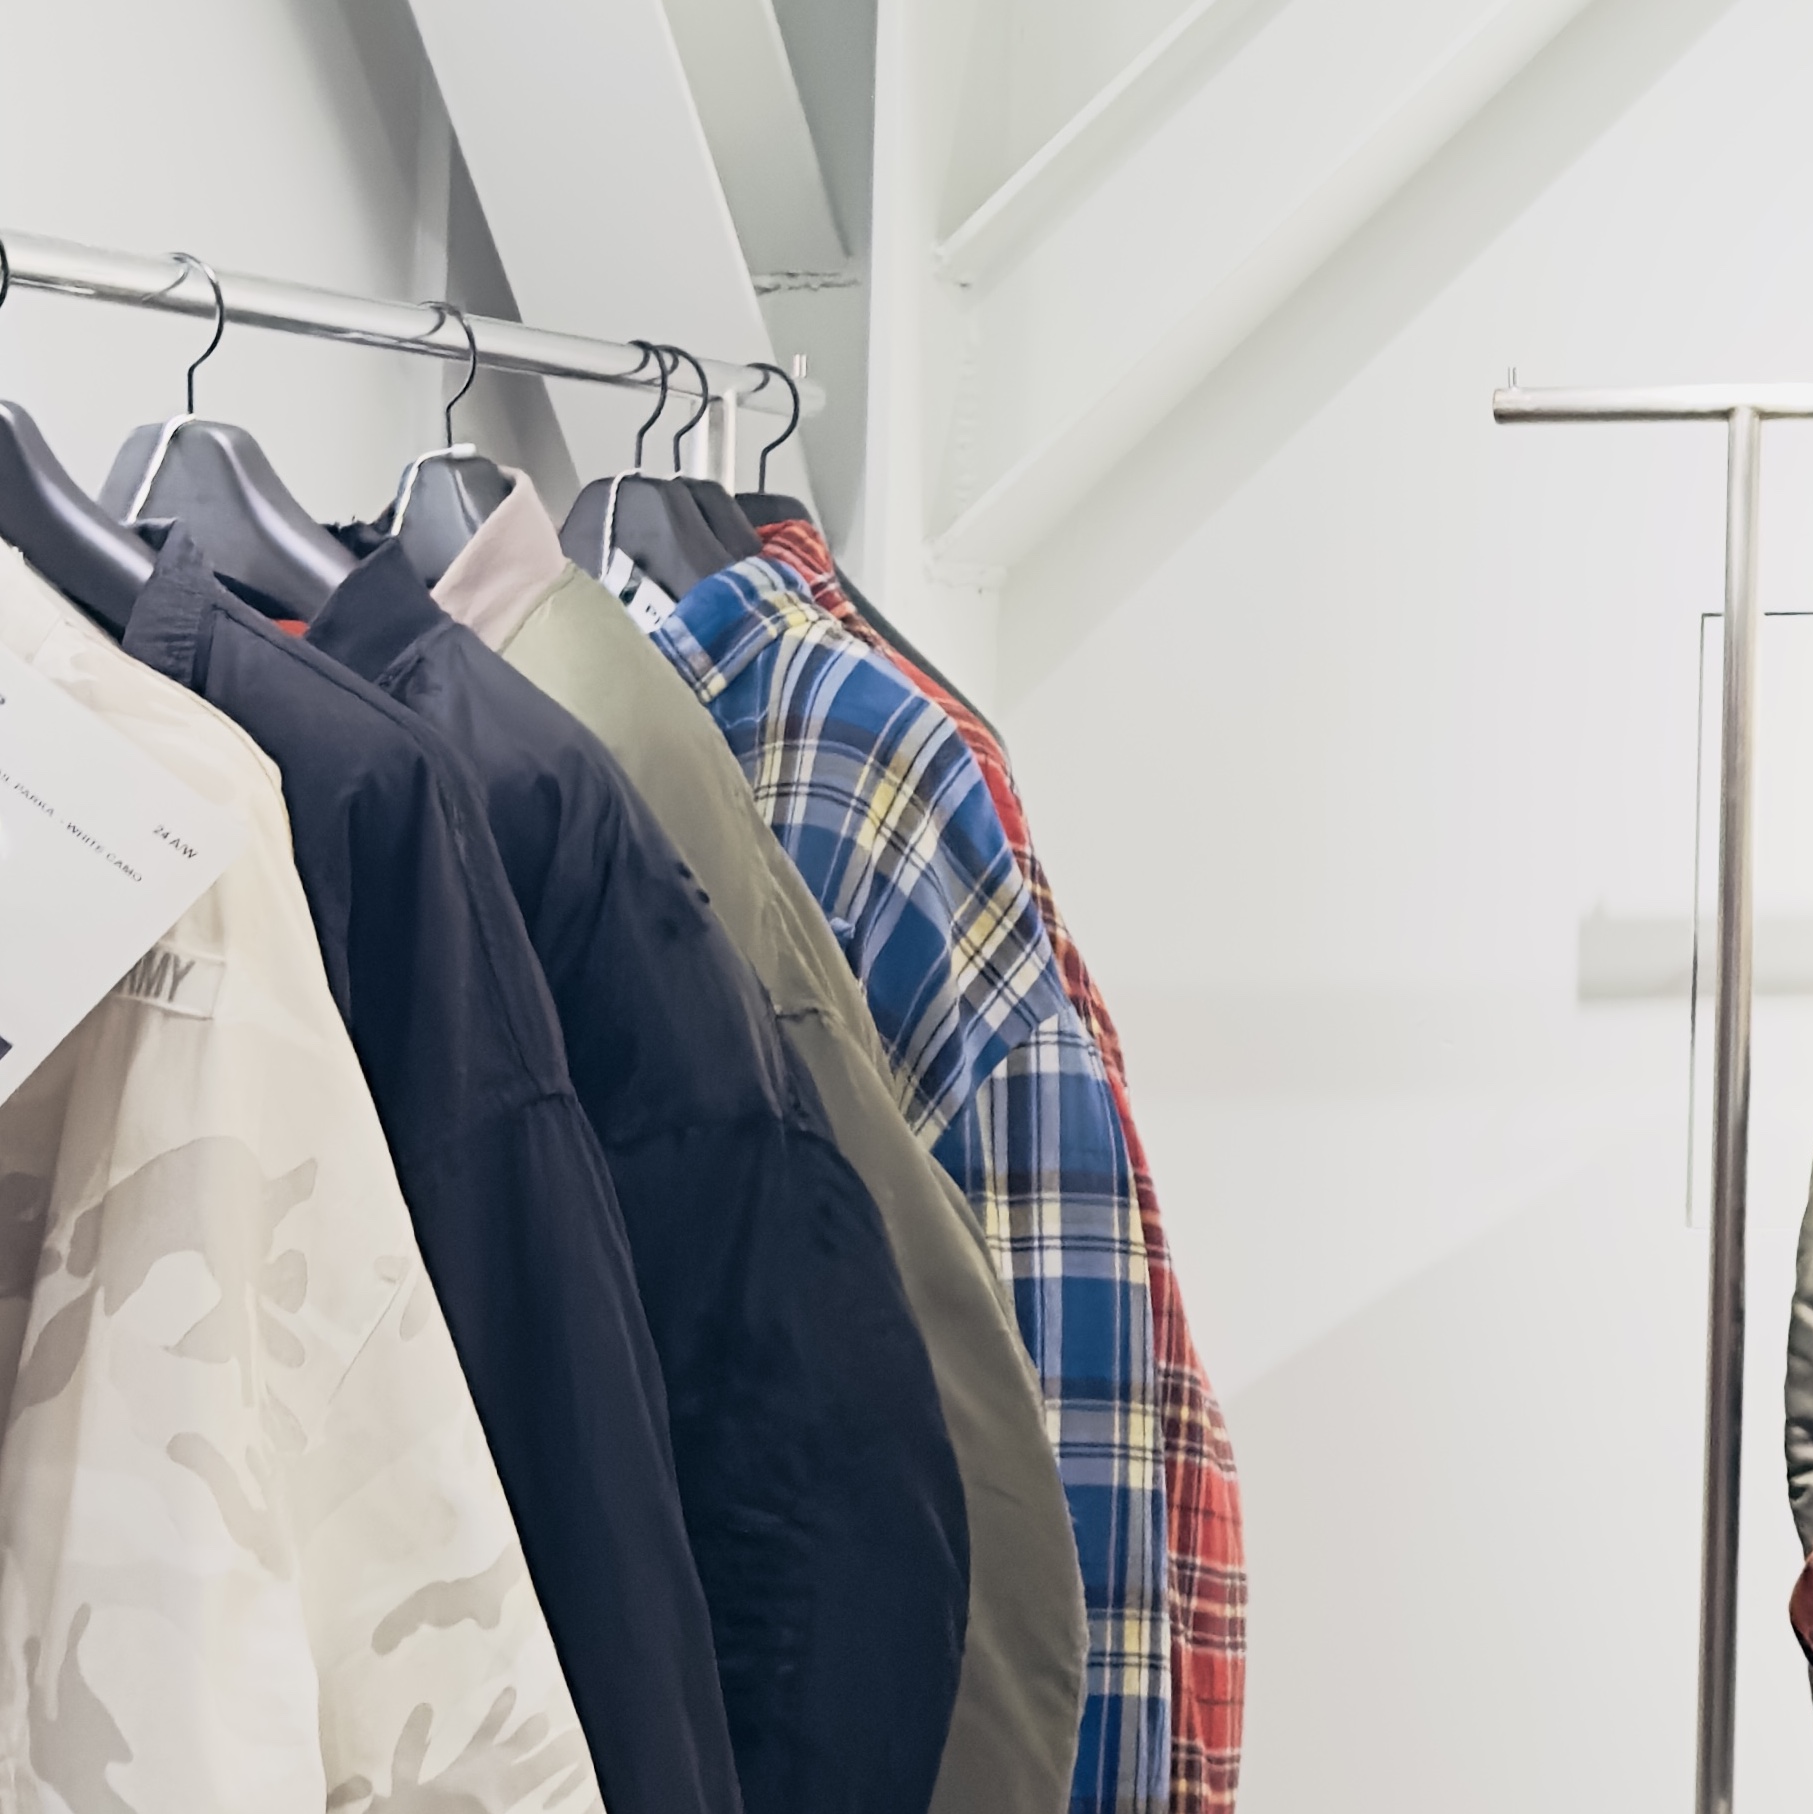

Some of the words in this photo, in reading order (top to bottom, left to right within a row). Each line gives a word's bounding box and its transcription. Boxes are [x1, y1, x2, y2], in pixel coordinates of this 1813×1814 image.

[13, 782, 54, 817] PARKA
[66, 822, 105, 855] WHITE
[105, 852, 143, 882] CAMO
[151, 823, 171, 842] 24
[168, 837, 199, 860] A/W
